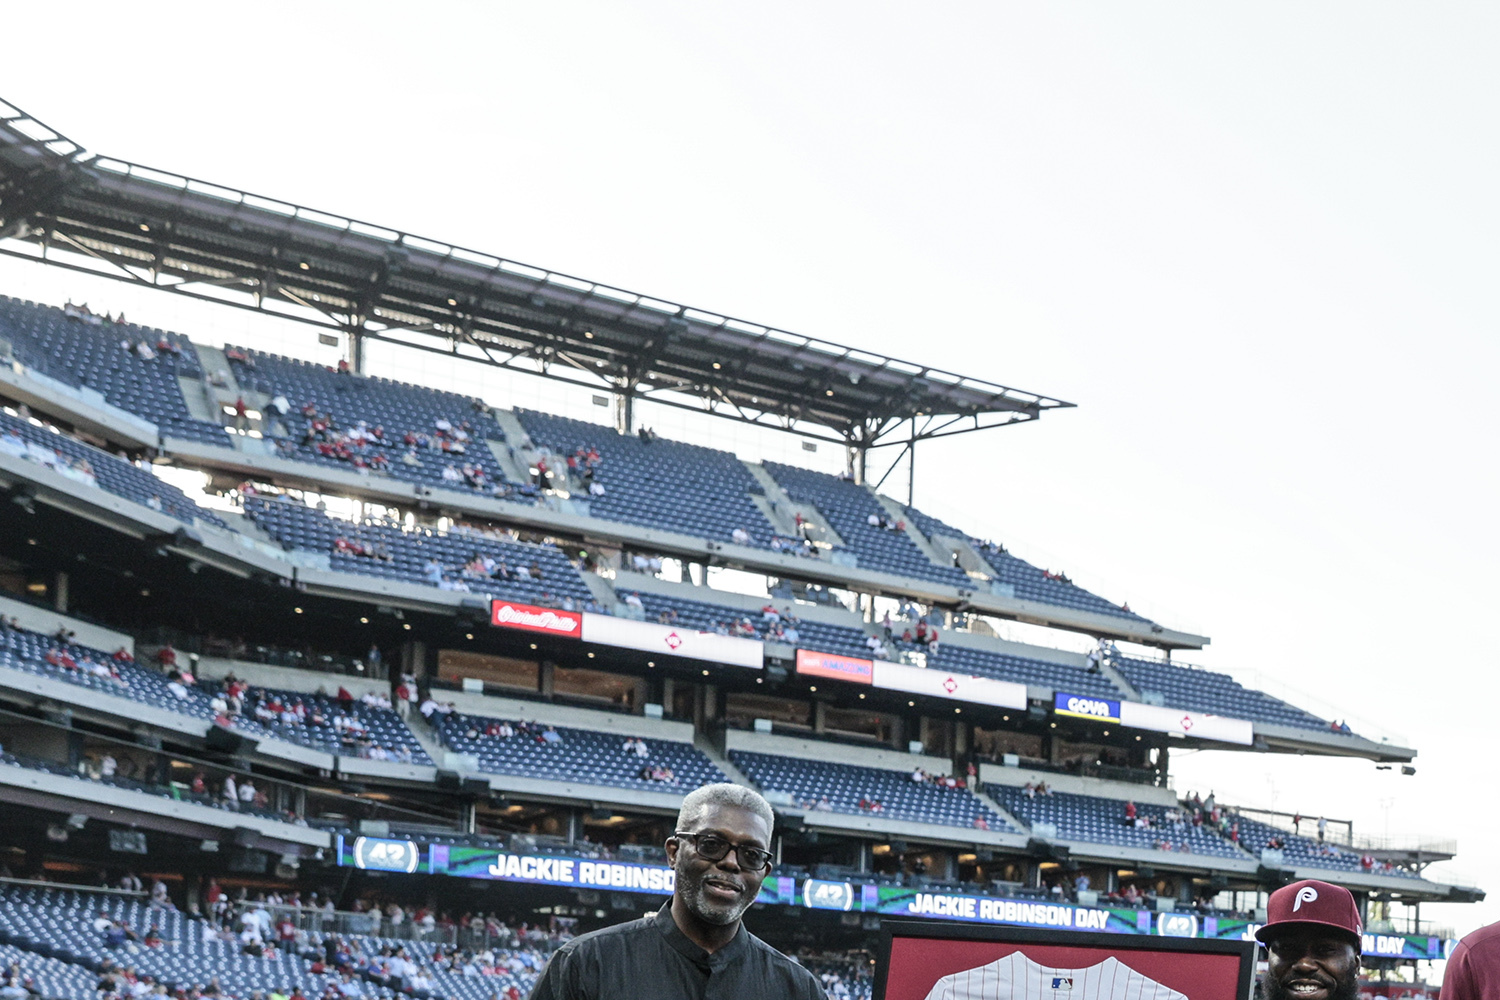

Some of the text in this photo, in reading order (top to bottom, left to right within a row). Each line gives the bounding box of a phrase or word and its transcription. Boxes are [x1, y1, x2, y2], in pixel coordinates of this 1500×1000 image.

[1067, 697, 1110, 716] GOYA
[488, 854, 574, 883] JACKIE
[908, 893, 1110, 930] JACKIE ROBINSON DAY
[1377, 936, 1406, 954] DAY
